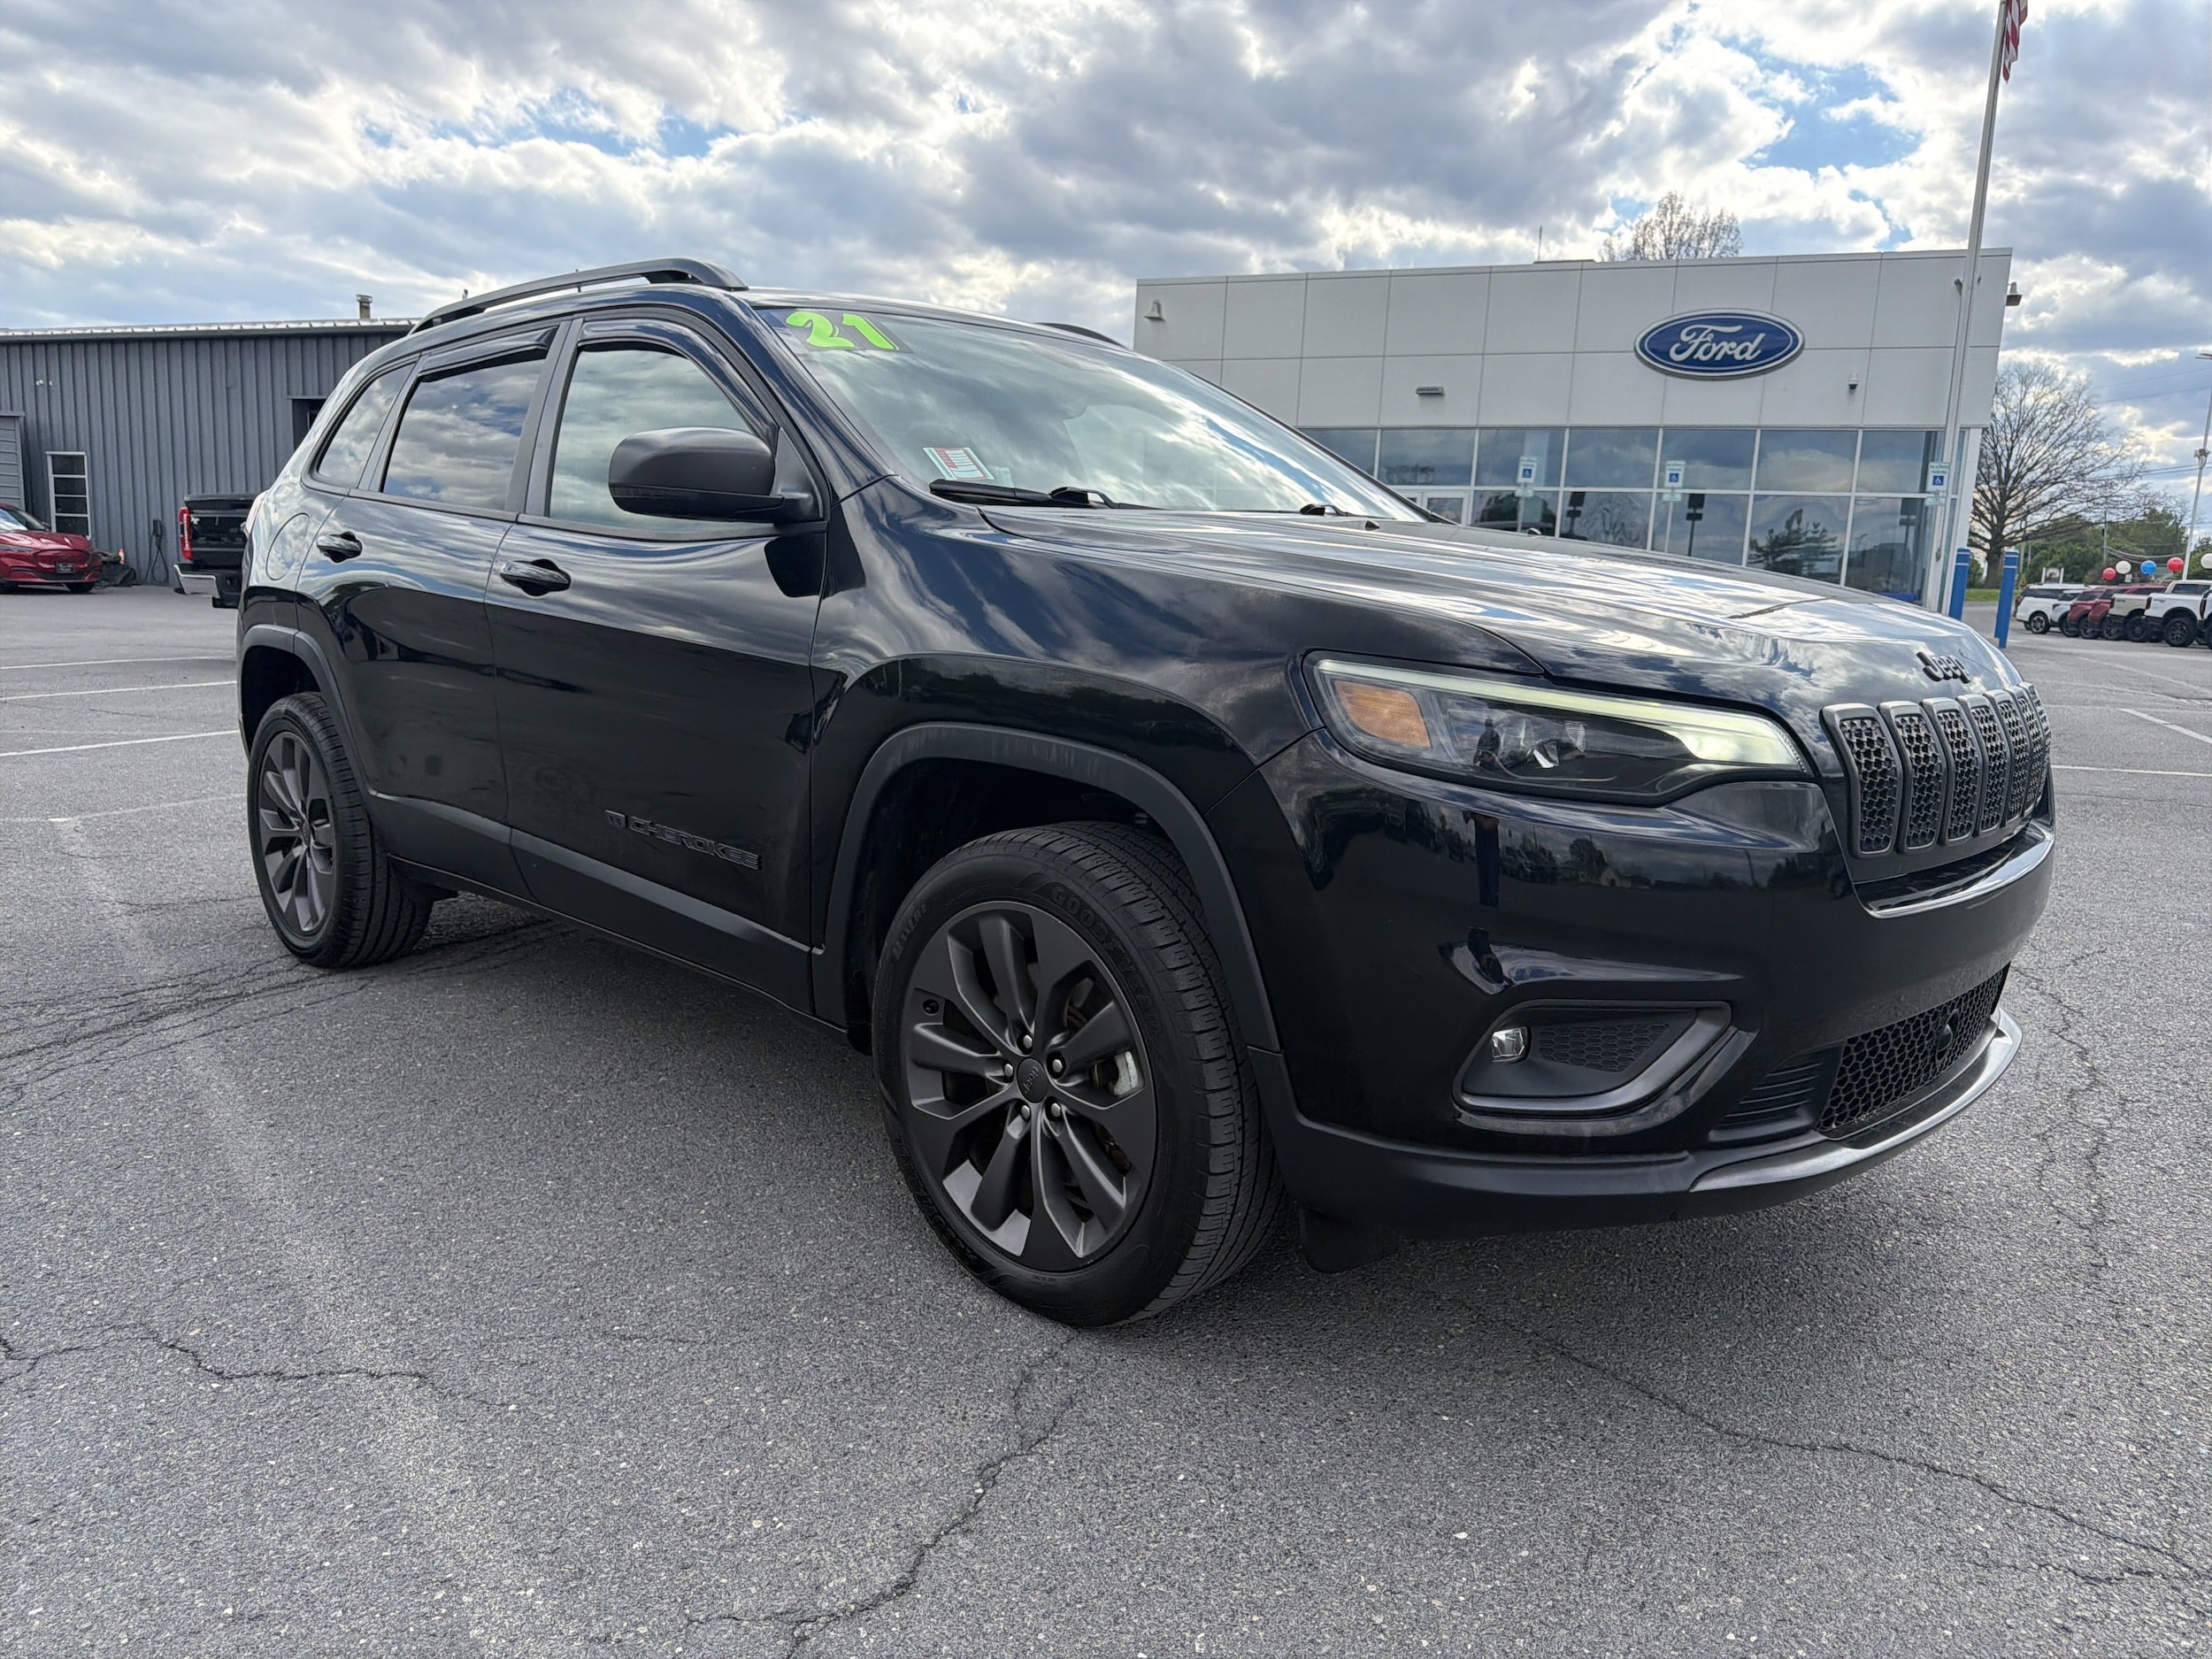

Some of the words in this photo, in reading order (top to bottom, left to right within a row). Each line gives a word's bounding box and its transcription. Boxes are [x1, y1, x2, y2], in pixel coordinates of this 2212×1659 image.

[786, 311, 899, 350] 21
[1669, 324, 1766, 362] Ford
[1916, 652, 1970, 683] Jeep
[629, 816, 759, 870] CHEROKEE
[1051, 884, 1163, 1035] GOODYEAR
[1023, 1065, 1040, 1094] Jeep
